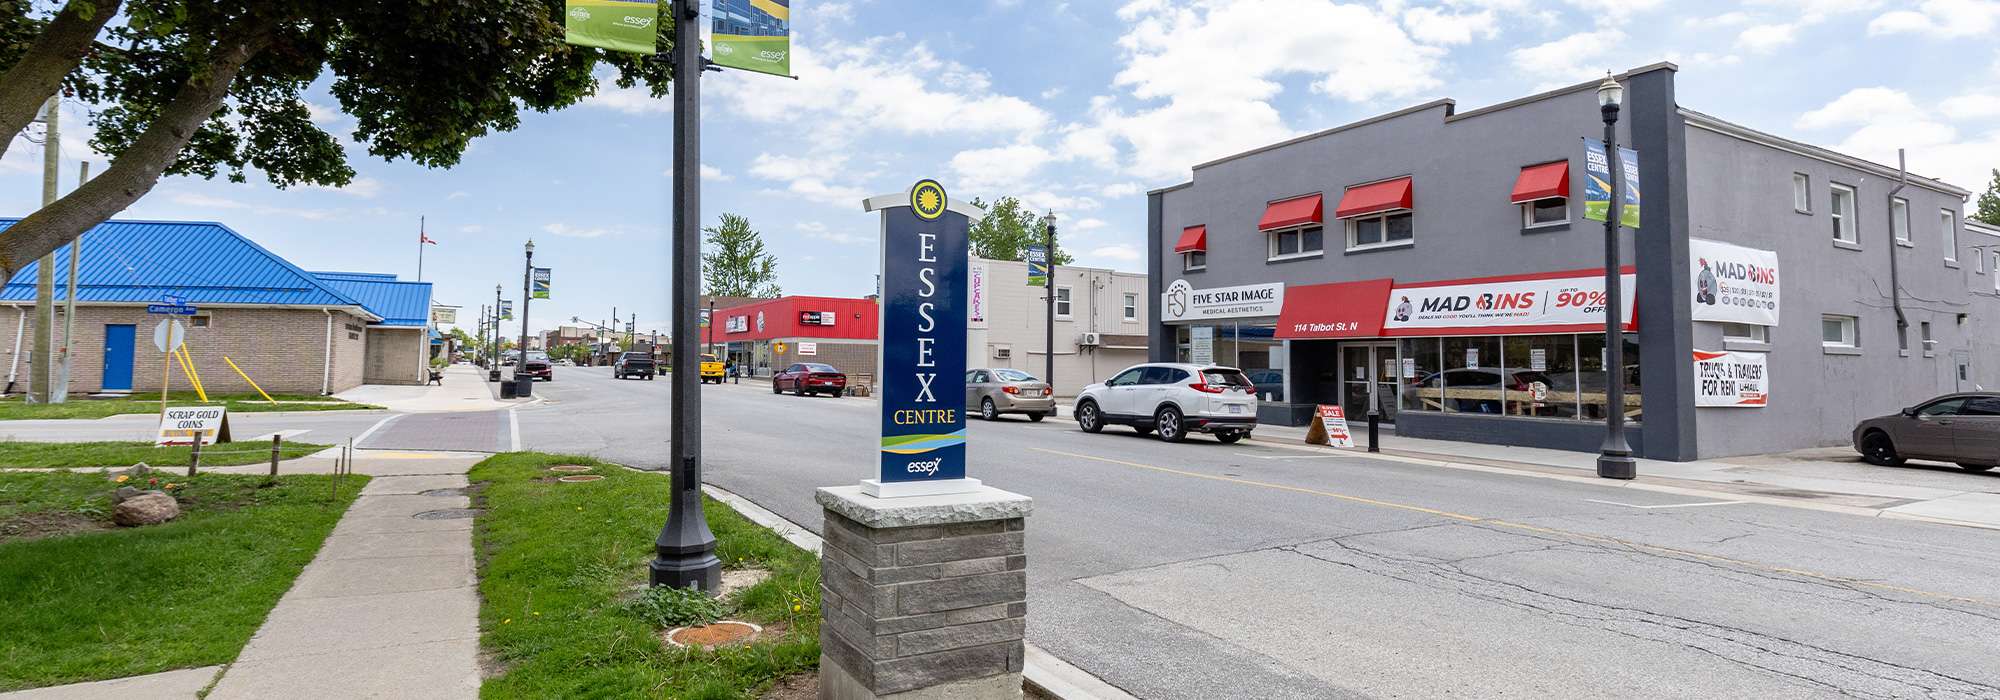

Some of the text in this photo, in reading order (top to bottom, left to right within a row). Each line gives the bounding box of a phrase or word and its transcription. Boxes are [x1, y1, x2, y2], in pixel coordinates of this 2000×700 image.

[623, 15, 653, 28] essex
[761, 50, 785, 63] essex
[1715, 260, 1775, 285] MAD BINS
[1193, 288, 1274, 304] FIVE STAR IMAGE
[1420, 292, 1535, 312] MAD BINS
[1555, 291, 1608, 307] 90%
[149, 305, 184, 313] Cameron
[1227, 306, 1263, 314] AESTHETICS
[915, 233, 937, 402] ESSEX
[1294, 321, 1358, 332] 114 Talbot St. N
[1700, 362, 1726, 379] TRUCKS
[1728, 363, 1732, 378] &
[1702, 380, 1736, 396] FOR RENT
[167, 410, 219, 419] SCRAP GOLD
[894, 409, 956, 425] CENTRE
[177, 420, 204, 429] COINS
[907, 457, 942, 476] essex
